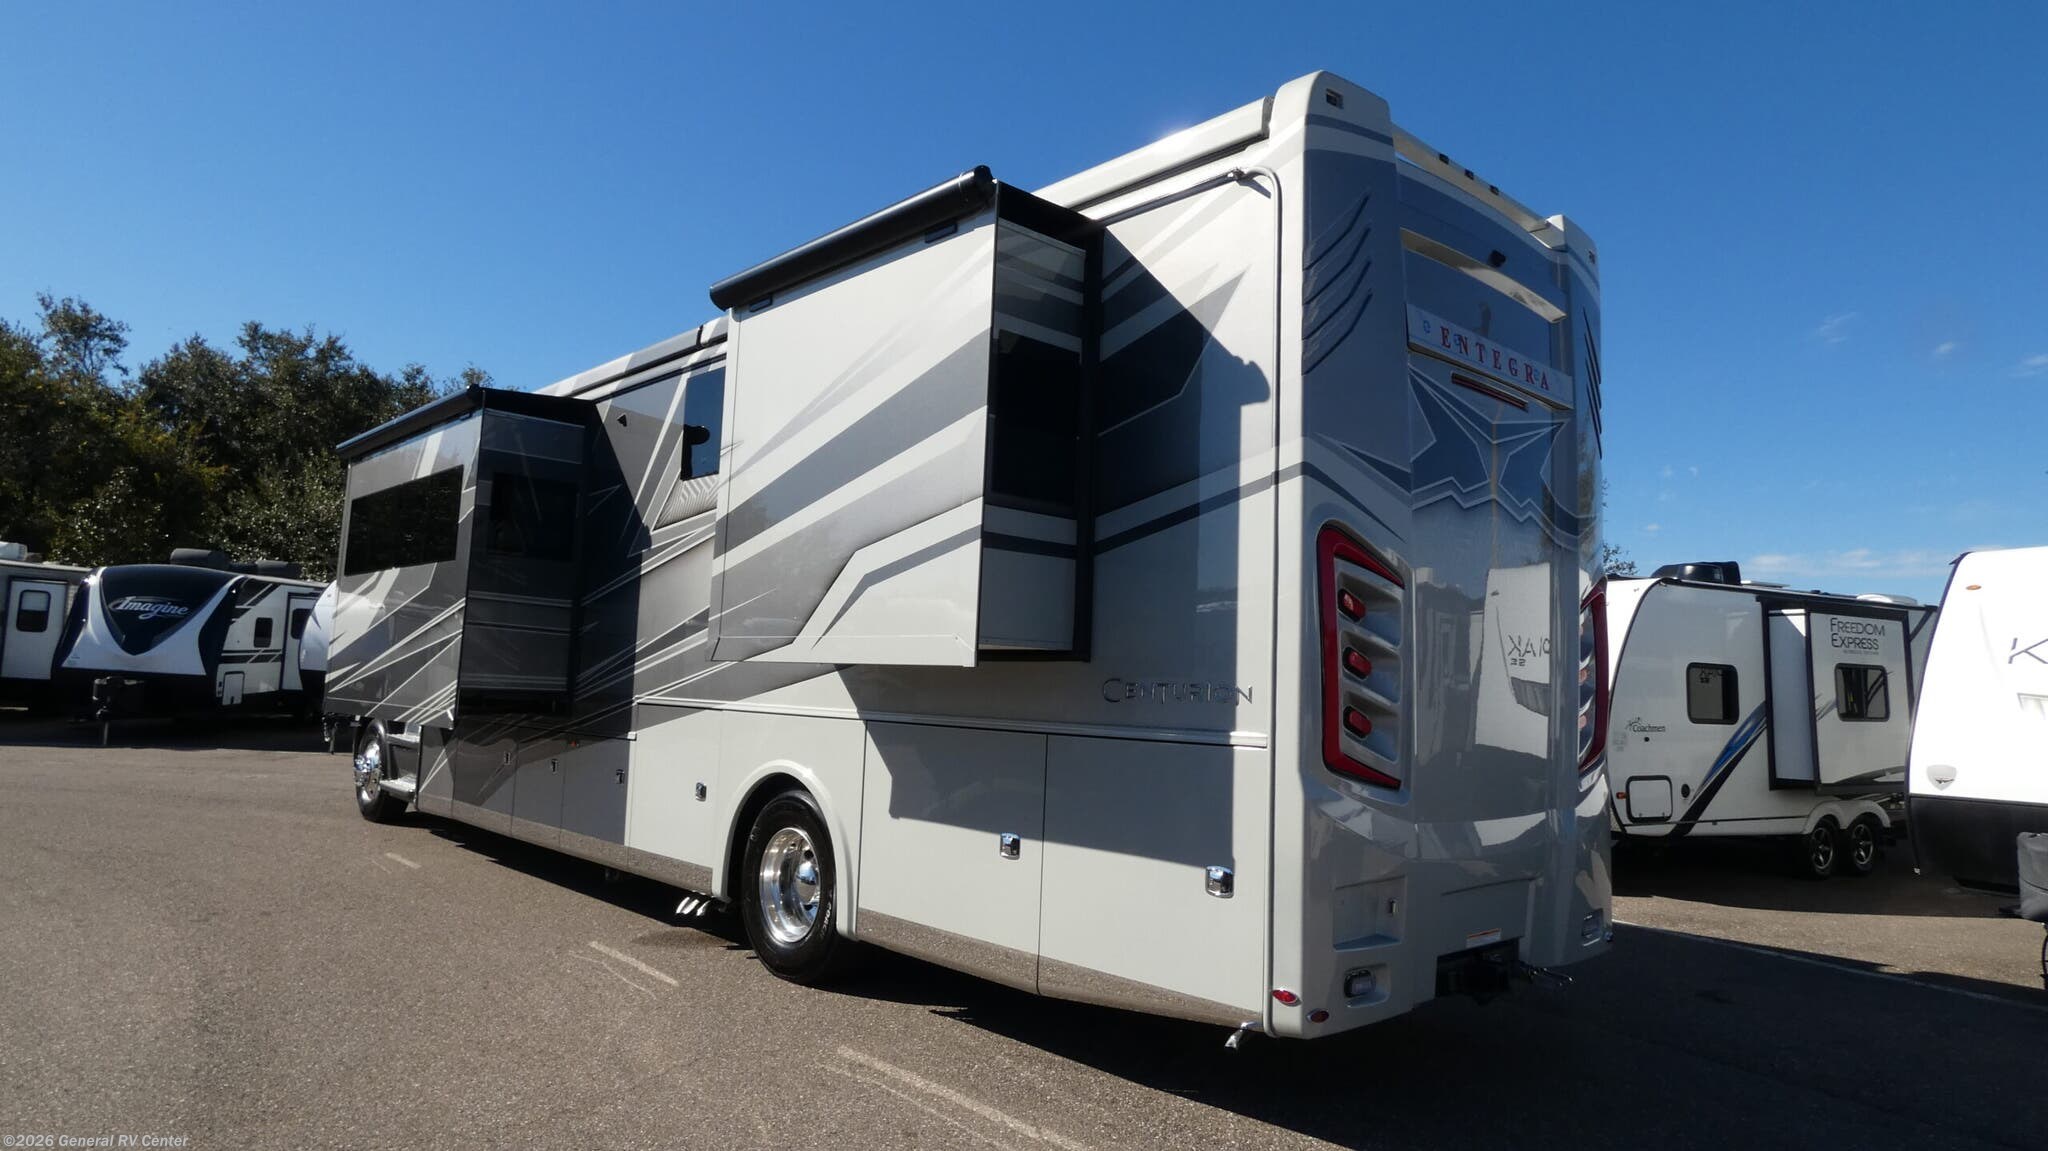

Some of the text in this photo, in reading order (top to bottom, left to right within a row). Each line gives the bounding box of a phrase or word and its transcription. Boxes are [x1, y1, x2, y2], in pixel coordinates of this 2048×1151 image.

[1440, 326, 1550, 391] ENTEGRA
[115, 596, 189, 620] Imagine
[1830, 617, 1886, 636] FREEDOM
[1831, 632, 1880, 650] EXPRESS
[1103, 678, 1252, 705] CENTURION
